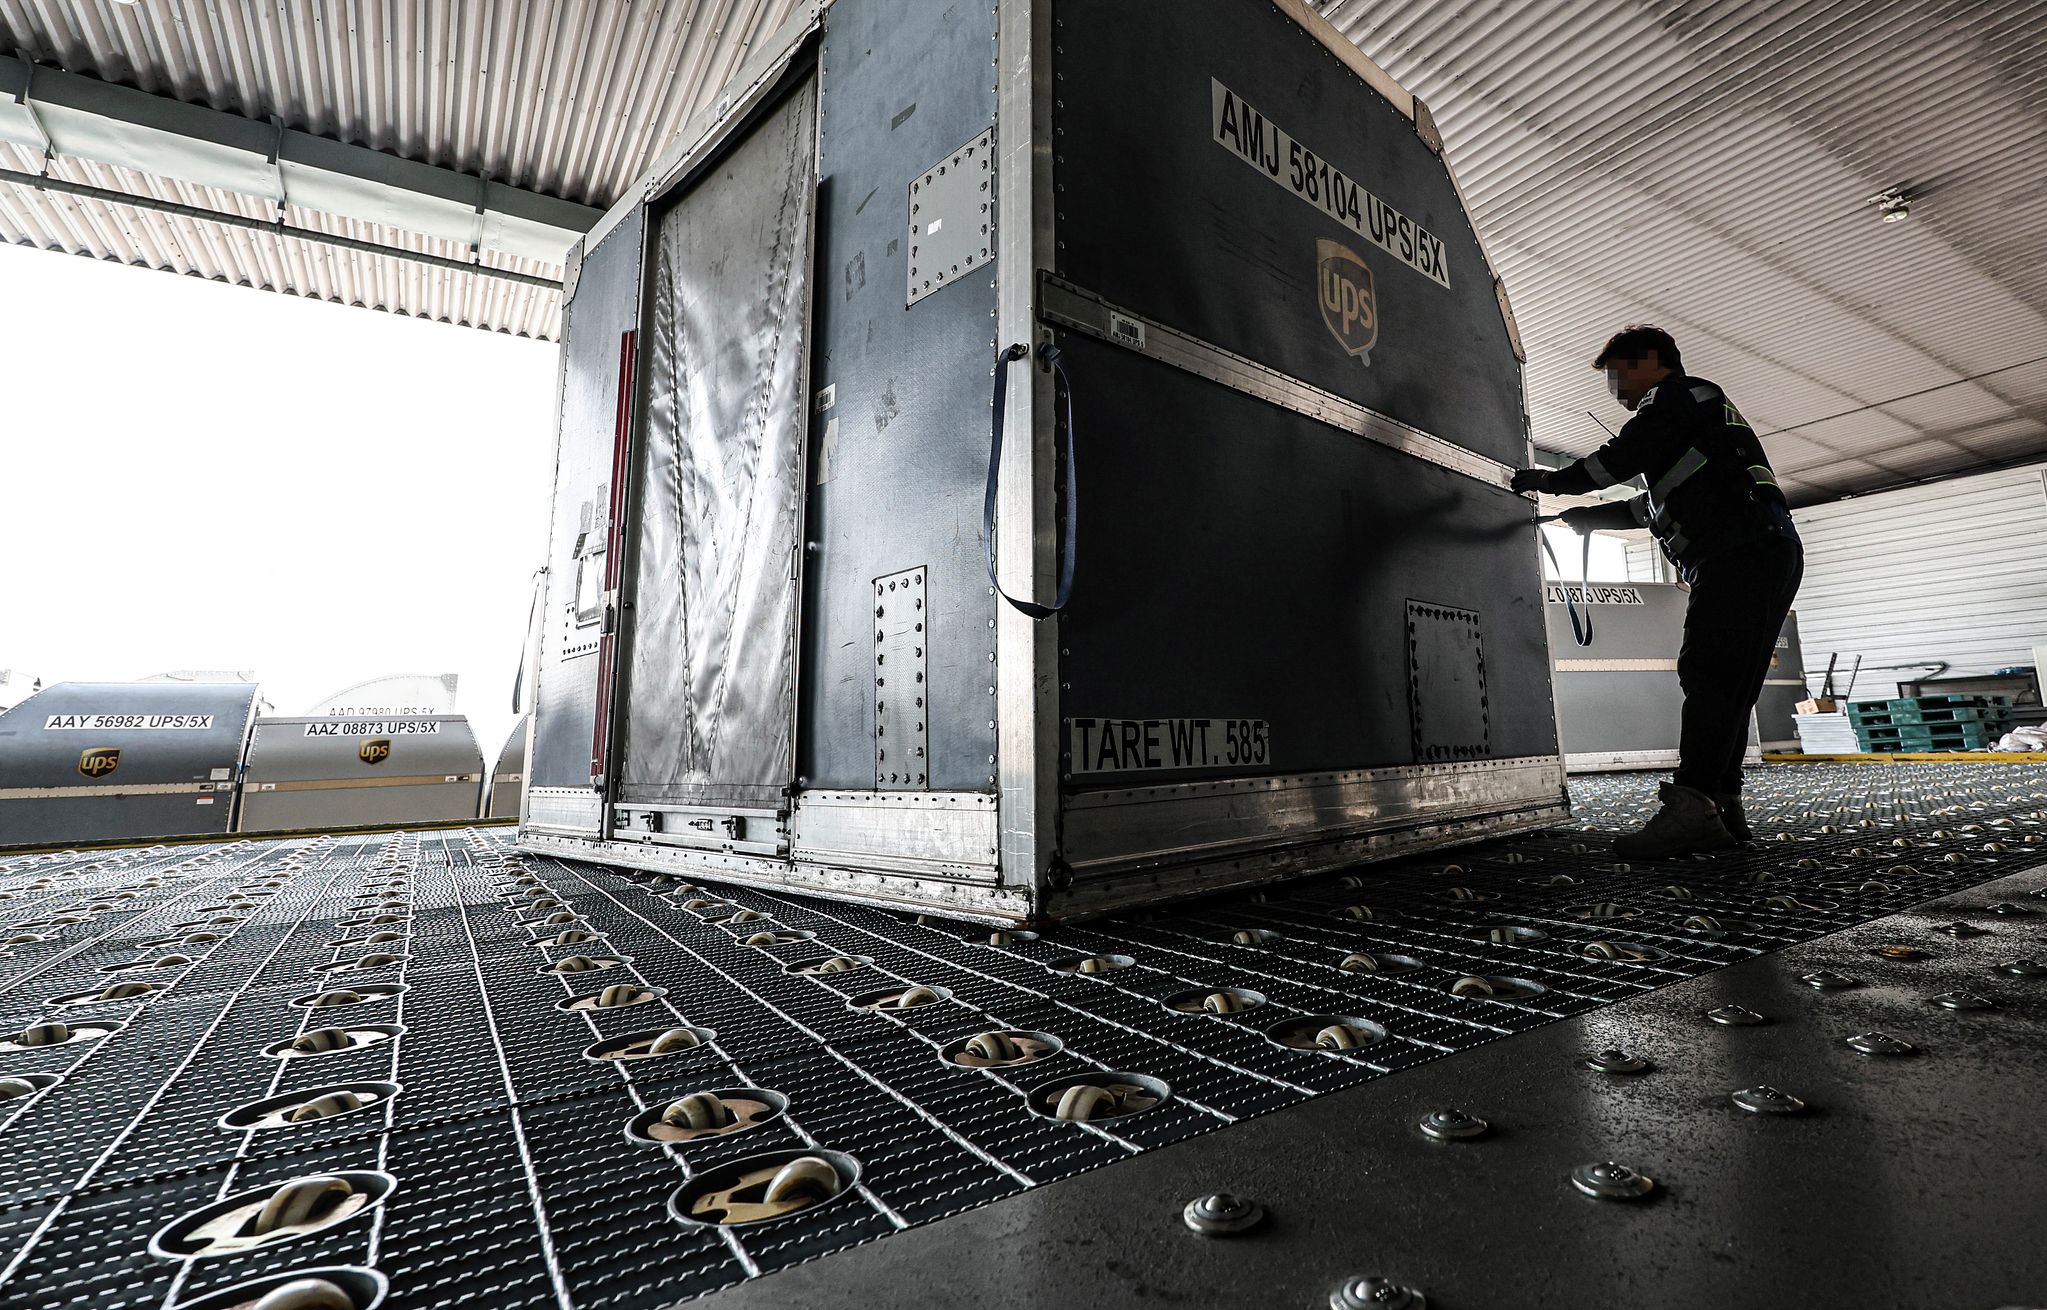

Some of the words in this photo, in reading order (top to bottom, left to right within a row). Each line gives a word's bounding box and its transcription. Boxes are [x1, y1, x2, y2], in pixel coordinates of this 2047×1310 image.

[1219, 89, 1280, 177] AMJ
[1289, 139, 1362, 230] 58104
[1366, 192, 1447, 283] UPS/5X
[1322, 268, 1373, 335] ups
[1592, 587, 1642, 604] UPS/5X
[48, 715, 91, 728] AAY
[94, 715, 145, 728] 56982
[149, 715, 213, 728] UPS/5X
[306, 723, 339, 736] AAZ
[342, 722, 384, 735] 08873
[387, 721, 438, 734] UPS/5X
[359, 745, 389, 761] ups
[1074, 718, 1162, 771] TARE
[1167, 719, 1219, 767] WT.
[1226, 719, 1267, 765] 585
[80, 755, 118, 775] ups
